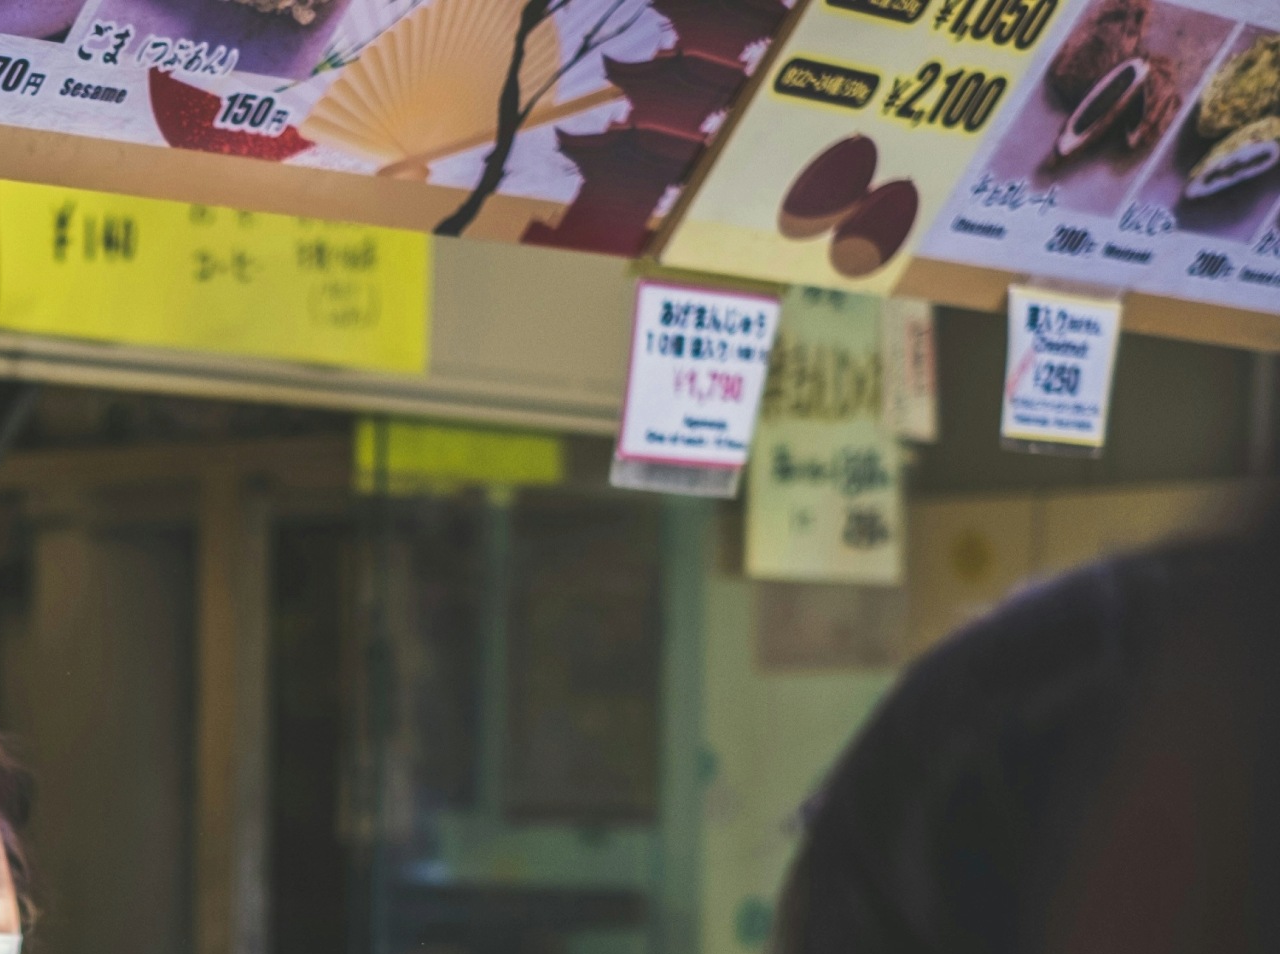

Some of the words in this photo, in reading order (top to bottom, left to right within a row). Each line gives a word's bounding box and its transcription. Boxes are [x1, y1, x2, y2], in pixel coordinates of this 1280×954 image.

[59, 77, 128, 104] Sesame
[883, 62, 1008, 132] ¥2,100
[219, 92, 289, 131] 150円
